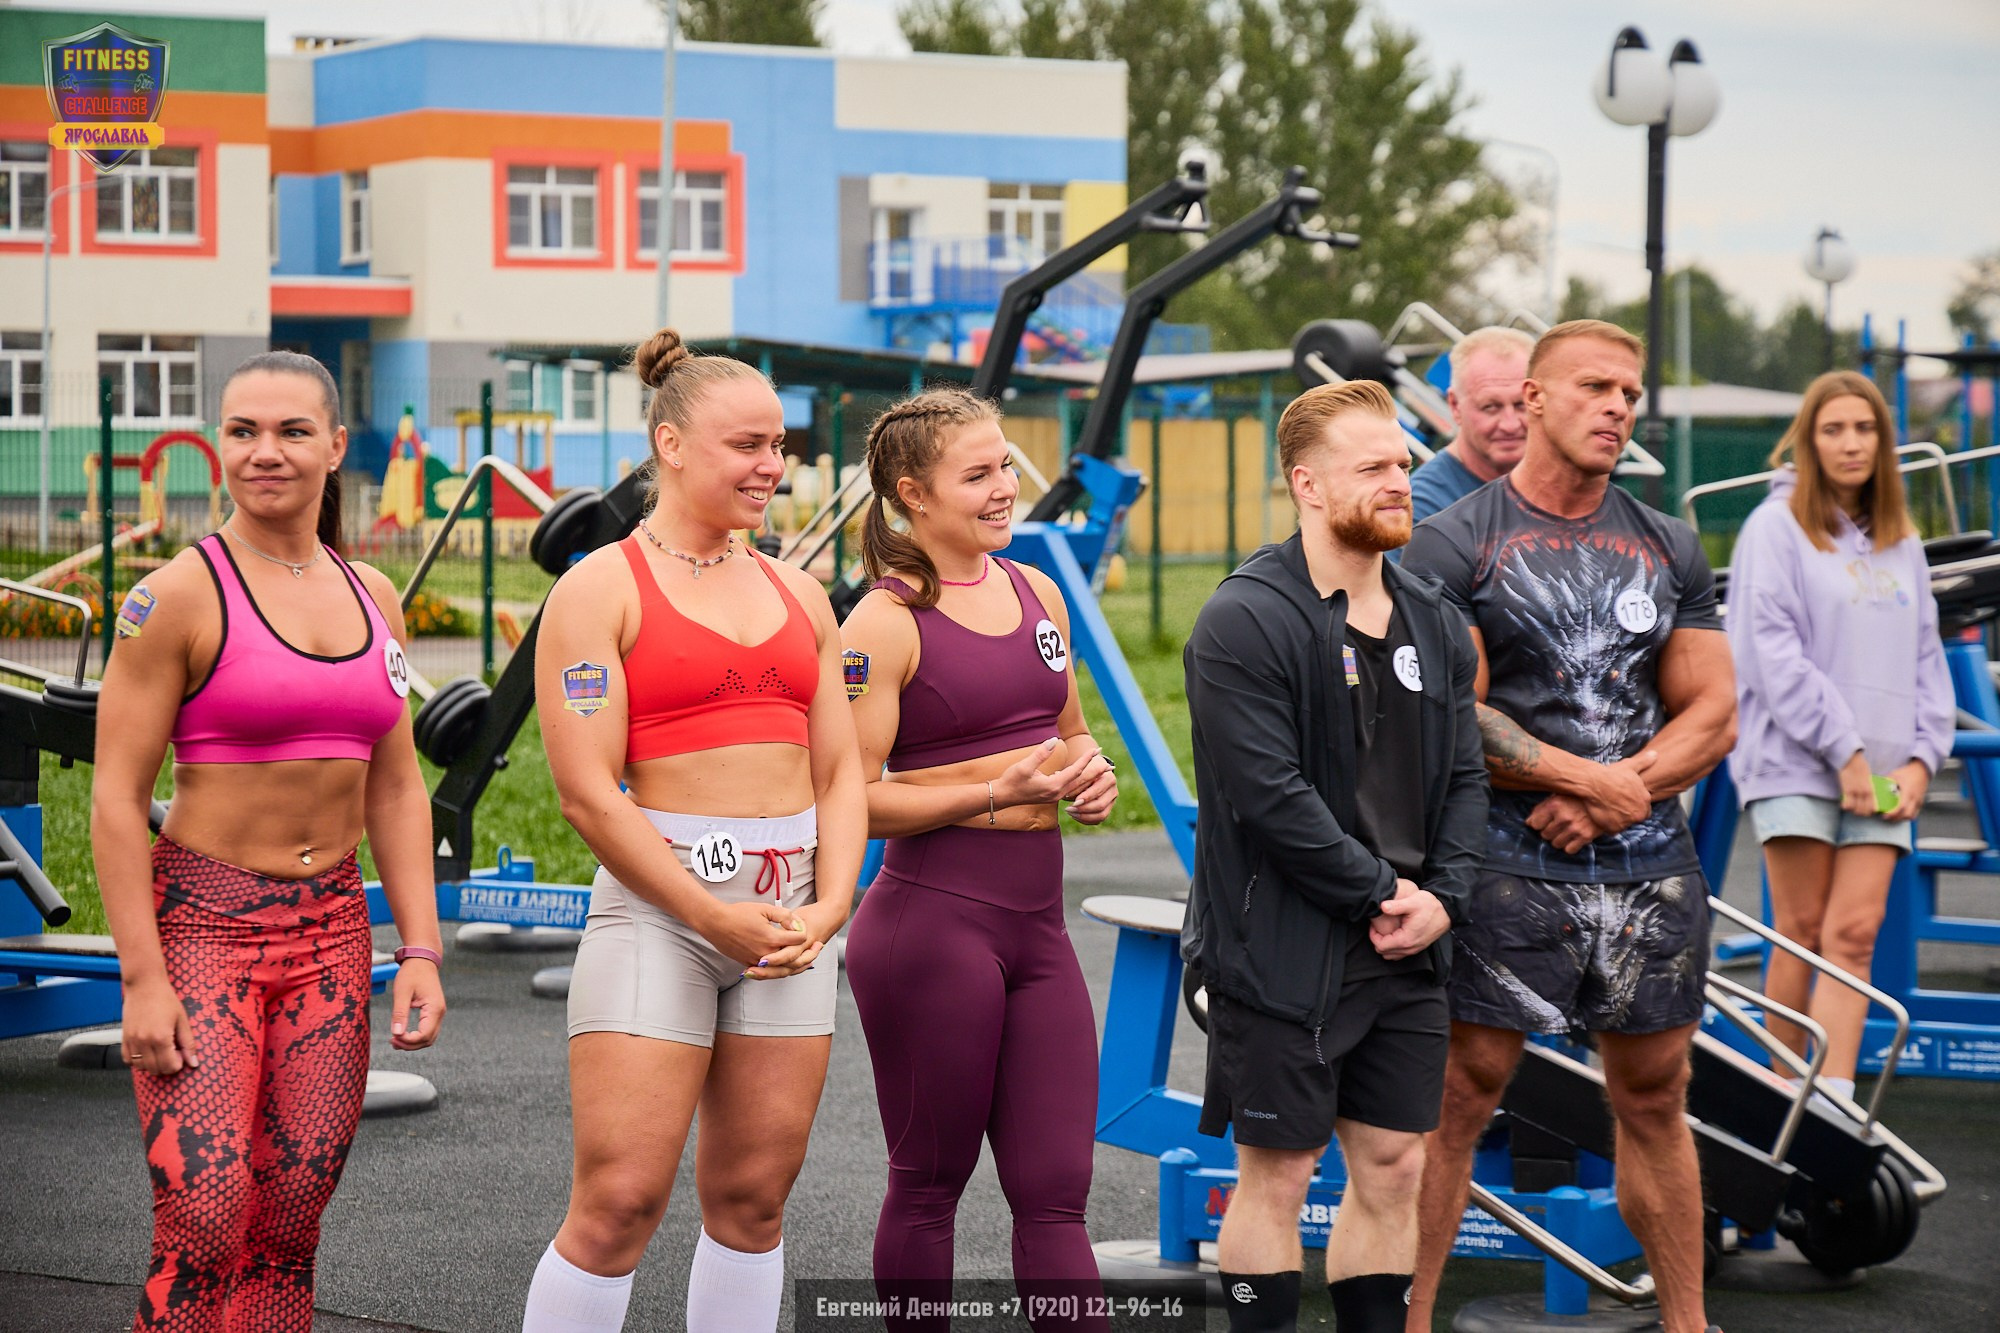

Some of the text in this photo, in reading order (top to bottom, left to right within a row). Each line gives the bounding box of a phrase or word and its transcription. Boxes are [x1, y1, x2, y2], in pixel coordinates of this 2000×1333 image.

[1621, 600, 1653, 622] 178
[1038, 630, 1066, 661] 52
[388, 651, 407, 683] 40
[842, 657, 864, 666] TNESS
[1398, 653, 1418, 679] 15
[567, 669, 603, 681] FITNESS
[696, 838, 737, 877] 143
[460, 888, 515, 906] STREET
[543, 908, 583, 926] LIGHT
[1208, 1187, 1234, 1216] M
[1454, 1235, 1504, 1249] ortmb.ru
